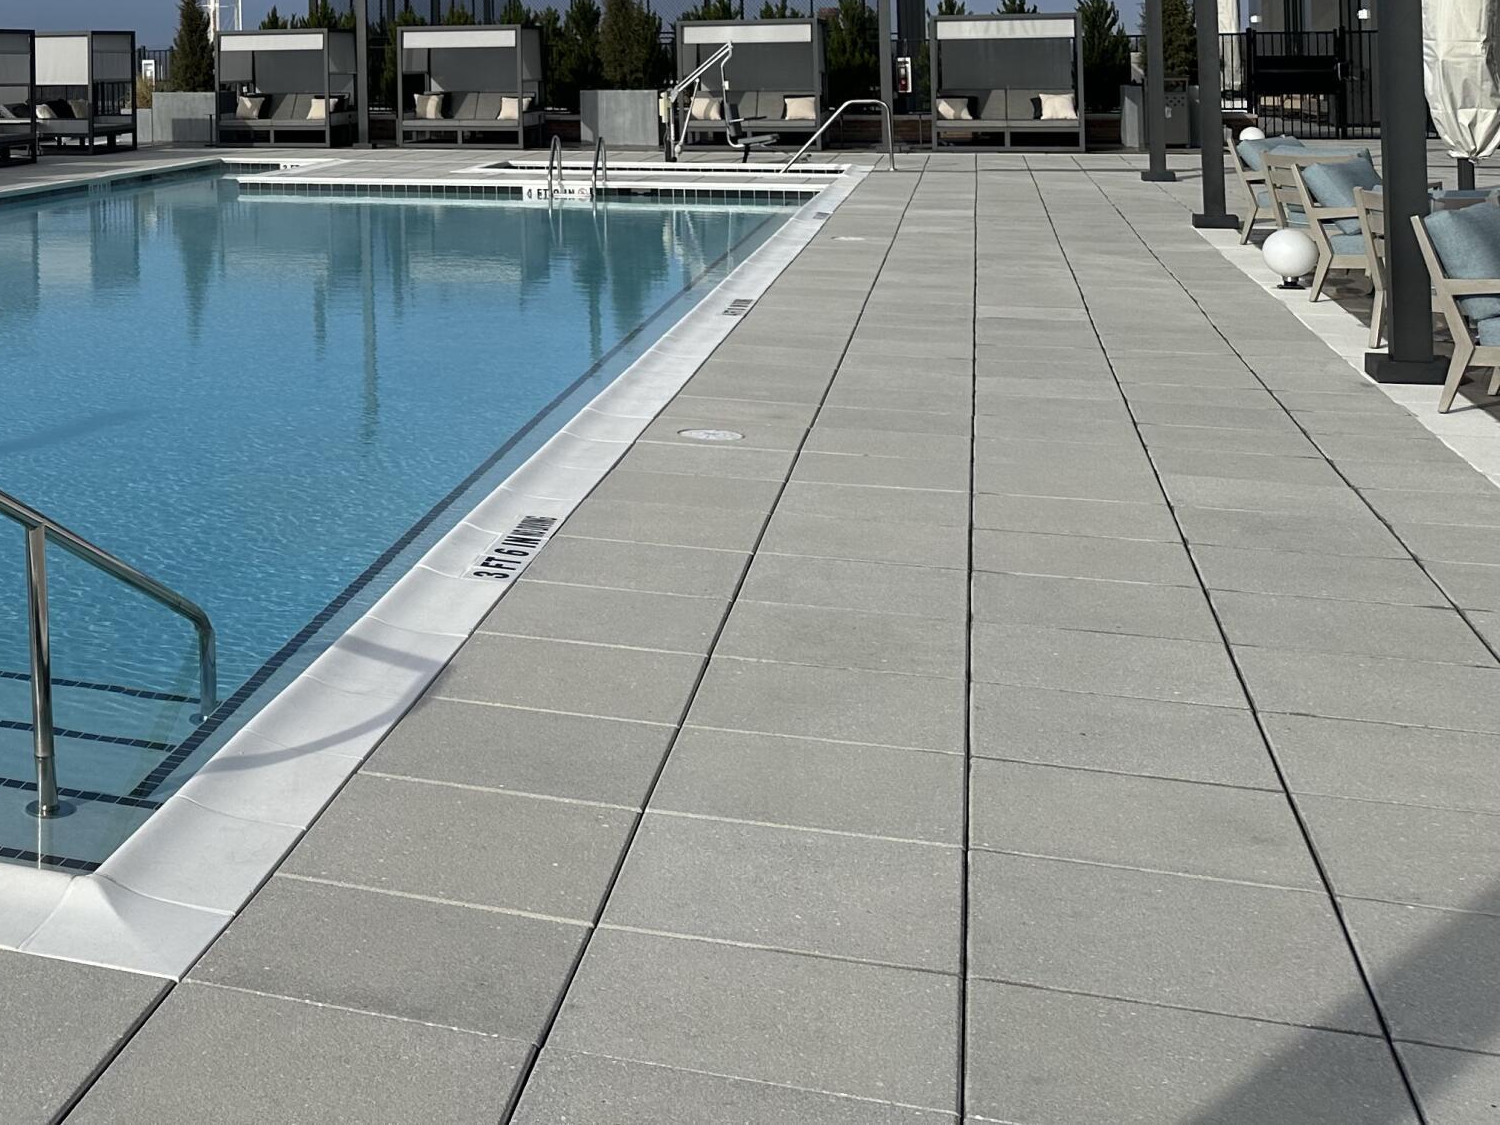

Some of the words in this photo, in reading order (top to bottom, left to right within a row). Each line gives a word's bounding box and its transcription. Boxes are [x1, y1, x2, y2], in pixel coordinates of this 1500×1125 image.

[501, 536, 542, 548] IN
[494, 548, 530, 557] 6
[480, 556, 522, 571] FT
[473, 571, 510, 579] 3
